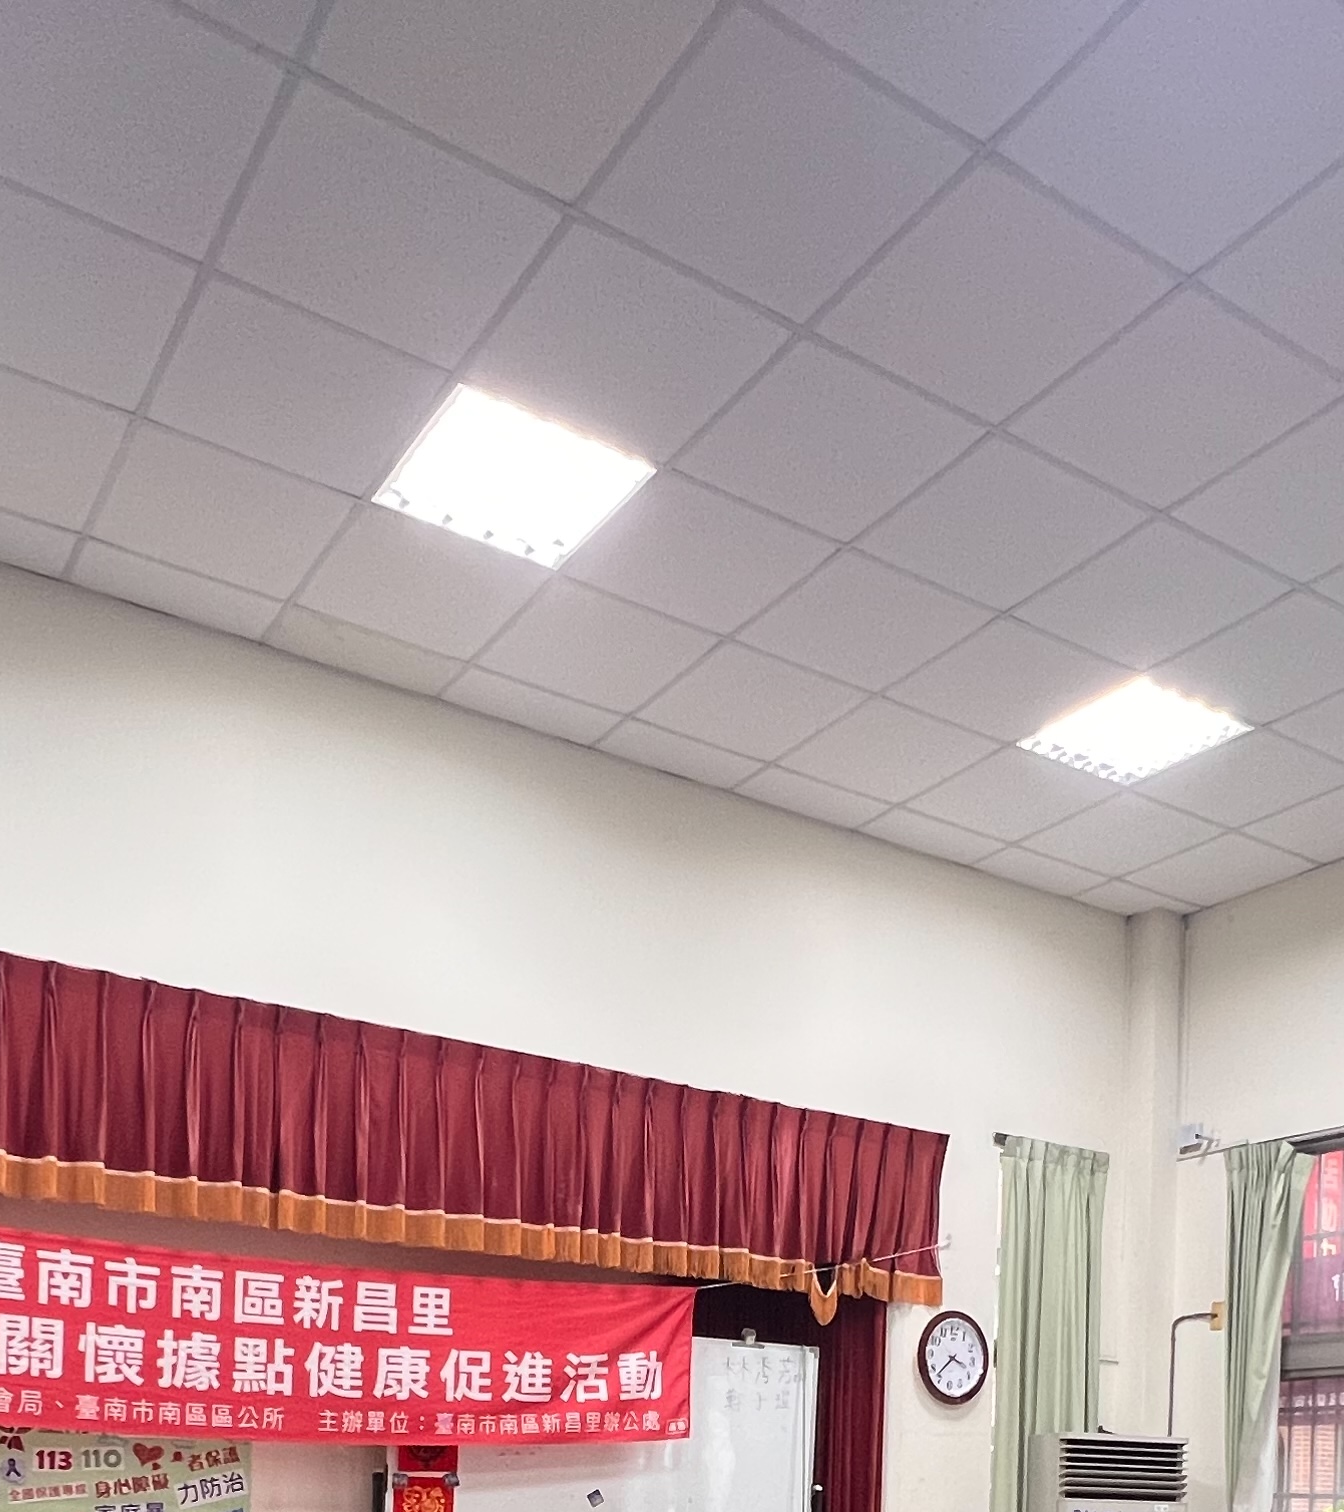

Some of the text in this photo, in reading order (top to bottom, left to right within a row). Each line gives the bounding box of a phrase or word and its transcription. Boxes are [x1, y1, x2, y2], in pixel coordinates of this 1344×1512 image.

[35, 1449, 122, 1470] 113 110
[178, 1472, 244, 1505] 力防治
